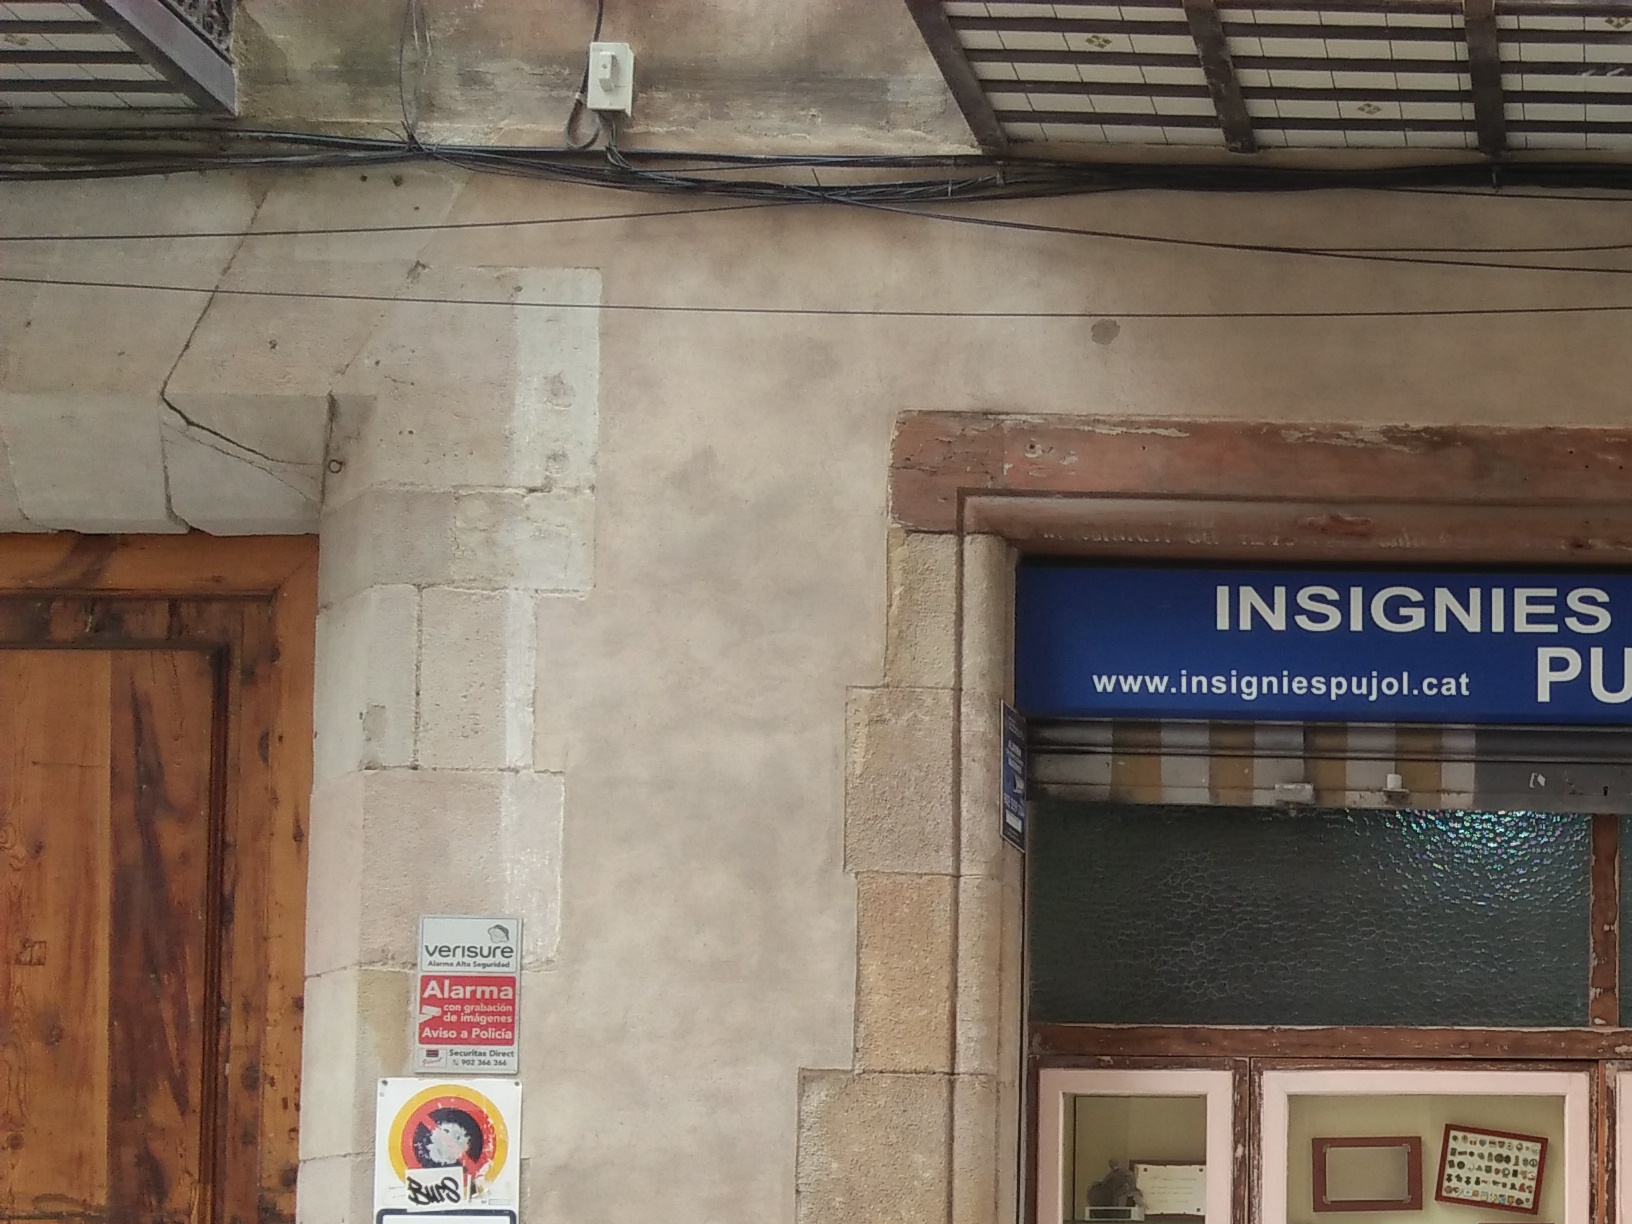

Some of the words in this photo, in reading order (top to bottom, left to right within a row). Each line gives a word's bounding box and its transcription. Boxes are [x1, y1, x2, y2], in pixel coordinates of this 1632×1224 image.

[1215, 585, 1613, 634] INSIGNIES
[1092, 669, 1471, 702] www.insigniespujol.cat
[424, 944, 515, 959] verisure
[427, 960, 454, 968] Alarma
[472, 961, 511, 970] Seguridad
[422, 979, 514, 1000] Alarma
[443, 1004, 462, 1012] con
[463, 1003, 513, 1014] grabación
[443, 1012, 458, 1022] de
[460, 1013, 513, 1025] imágenes
[421, 1027, 457, 1039] Aviso
[460, 1029, 468, 1039] a
[471, 1028, 513, 1040] Policía
[449, 1049, 487, 1058] Securitas
[489, 1050, 515, 1058] Direct
[461, 1059, 476, 1067] 902
